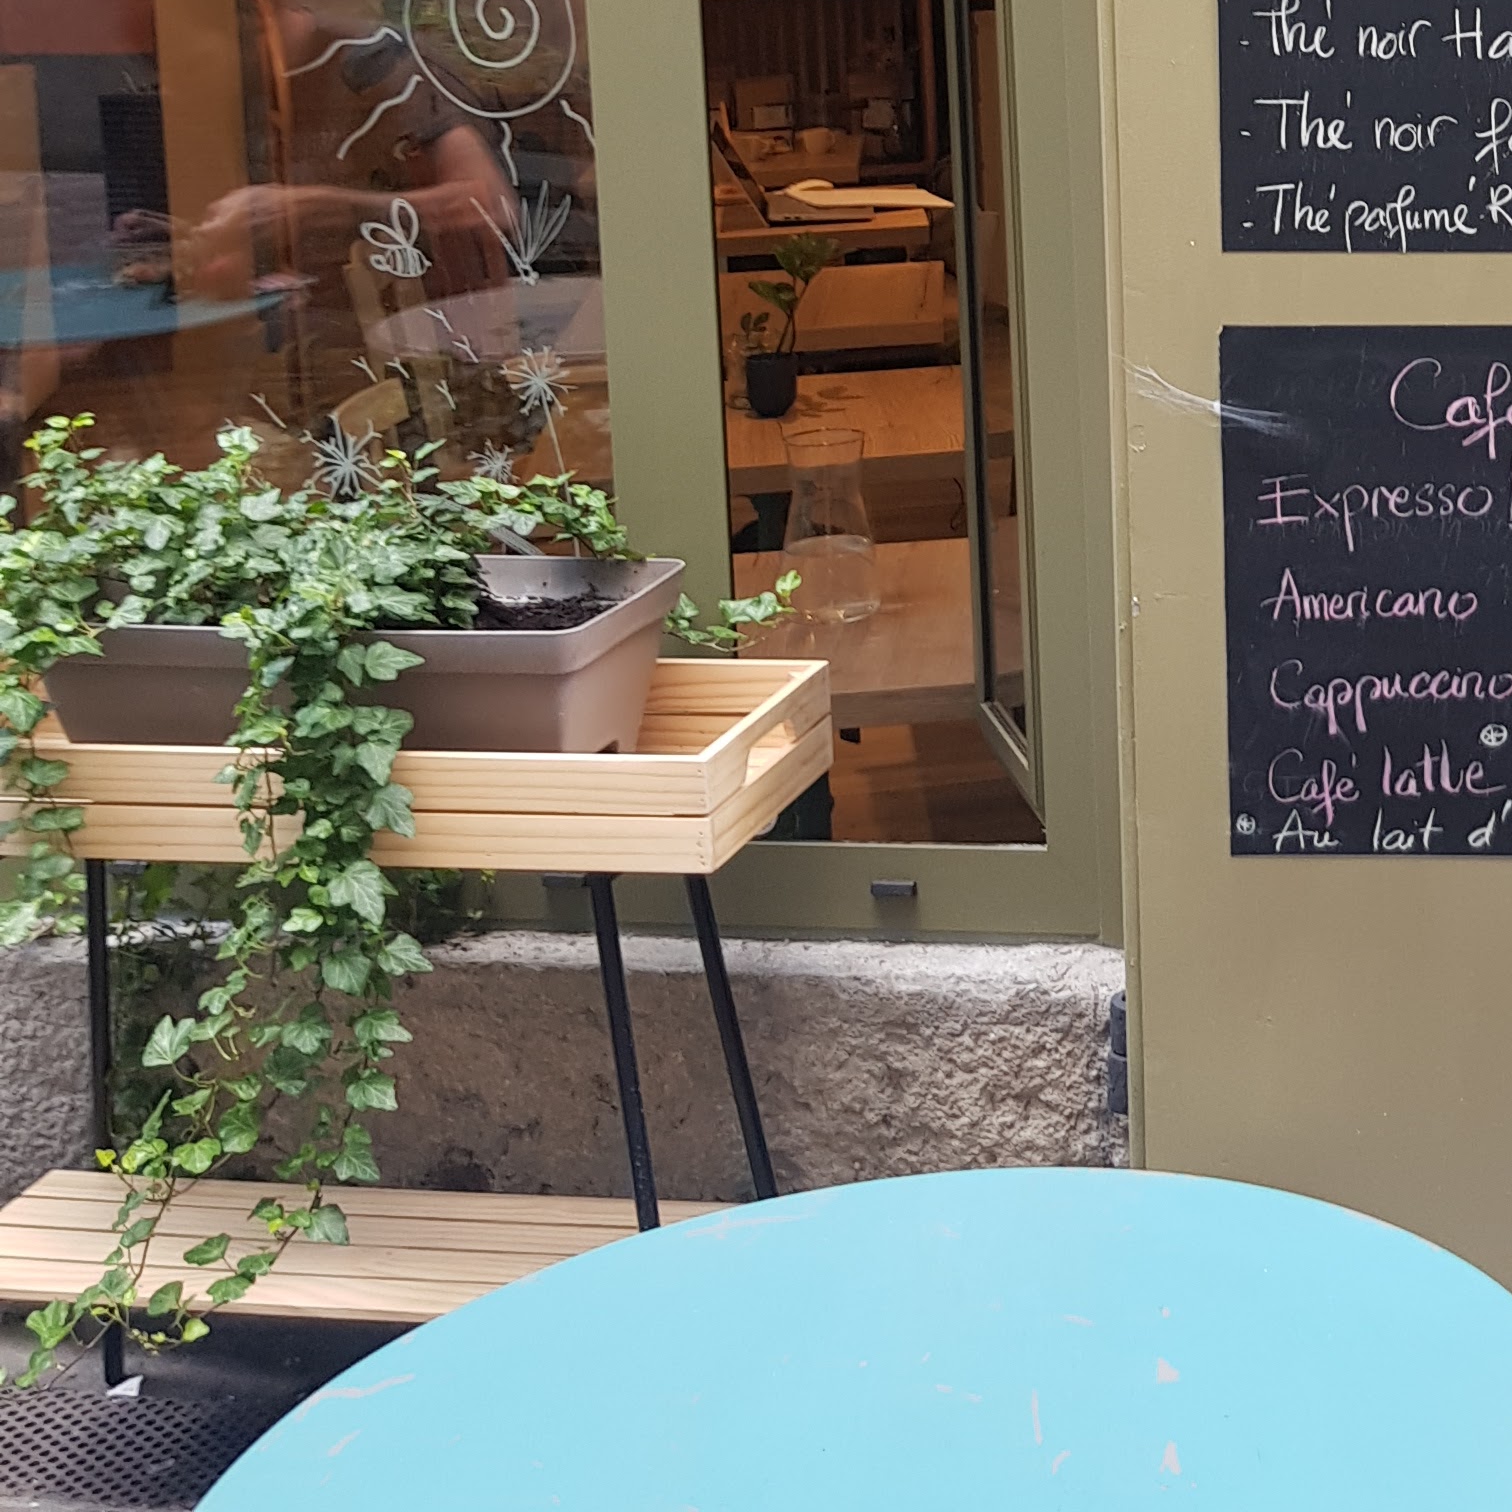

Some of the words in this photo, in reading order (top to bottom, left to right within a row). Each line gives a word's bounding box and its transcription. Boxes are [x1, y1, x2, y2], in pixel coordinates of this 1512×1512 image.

[1358, 20, 1433, 60] noir
[1254, 90, 1354, 146] Thé
[1375, 113, 1458, 148] noir
[1255, 181, 1331, 235] Thé
[1261, 567, 1480, 622] Americano
[1268, 747, 1360, 827] Café
[1272, 808, 1340, 852] Au
[1371, 807, 1444, 852] lait
